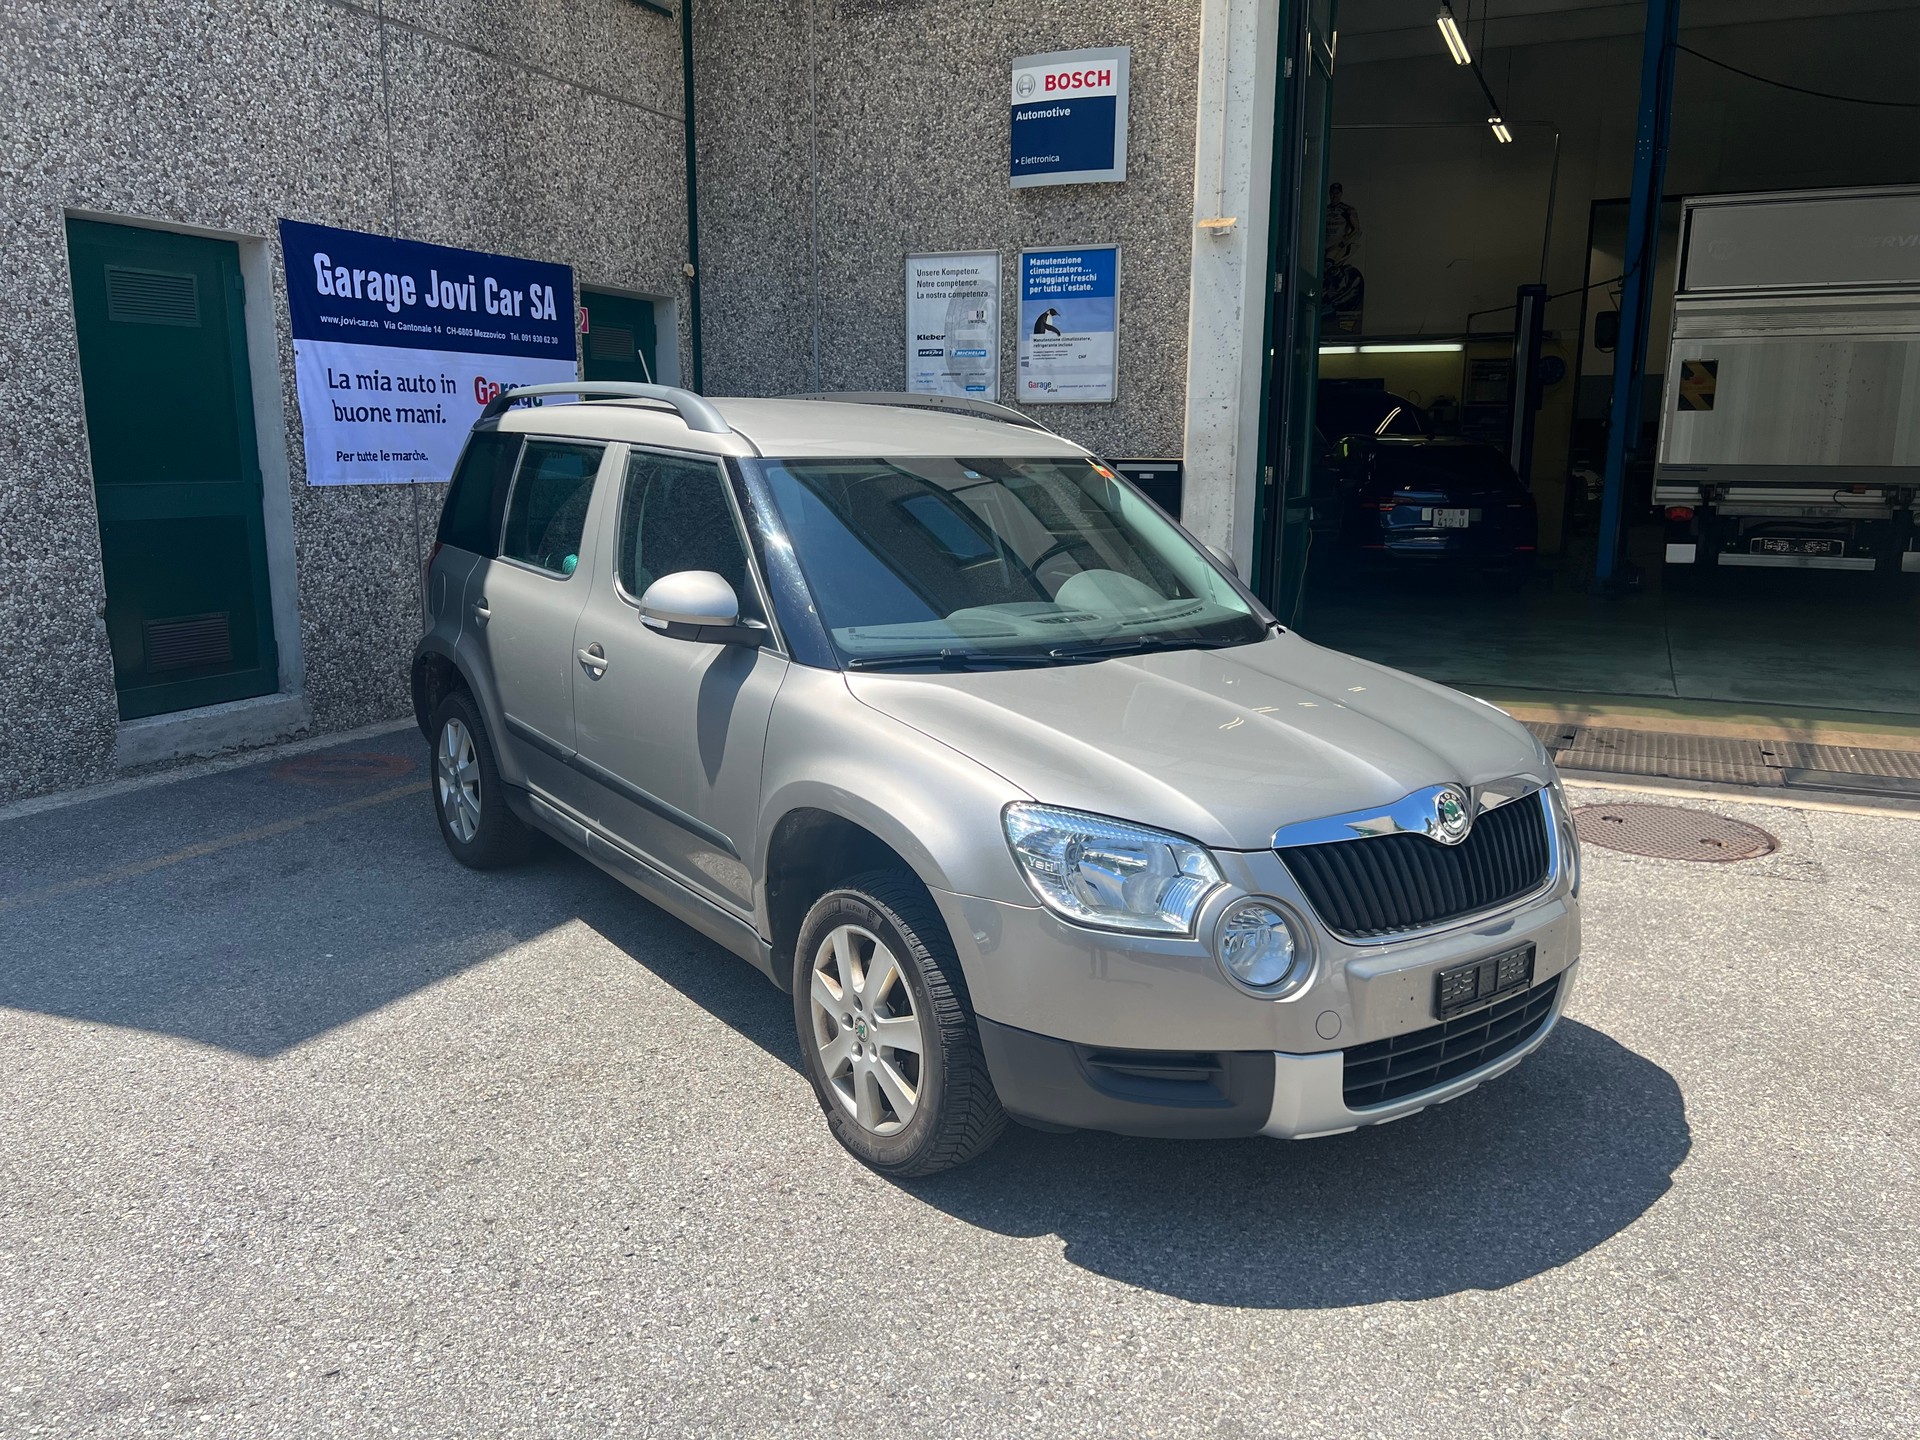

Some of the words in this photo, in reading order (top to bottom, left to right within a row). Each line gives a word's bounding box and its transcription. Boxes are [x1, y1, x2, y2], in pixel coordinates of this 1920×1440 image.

[1045, 70, 1110, 91] BOSCH
[1016, 106, 1071, 121] Automotive
[1020, 154, 1060, 165] Elettronica
[1030, 256, 1082, 266] Manutenzione
[916, 269, 940, 277] Unsere
[941, 268, 980, 277] Kompetenz.
[1029, 266, 1091, 275] climatizzatore...
[916, 280, 935, 288] Notre
[936, 279, 980, 289] compétence.
[1035, 275, 1070, 284] viaggiate
[1070, 273, 1097, 282] freschi
[313, 252, 417, 313] Garage
[425, 270, 477, 312] Jovi
[484, 277, 523, 316] Car
[529, 283, 557, 321] SA
[1029, 286, 1042, 295] per
[1062, 283, 1094, 292] l'estate.
[916, 291, 925, 299] La
[925, 291, 947, 299] nostra
[947, 291, 990, 299] competenza.
[320, 315, 379, 328] www.jovi-car.ch
[384, 320, 396, 329] Via
[397, 321, 432, 333] Cantonale
[433, 325, 442, 334] 14
[446, 326, 473, 337] CH-6805
[474, 329, 506, 340] Mezzovico
[510, 332, 520, 341] Tel.
[521, 333, 531, 342] 091
[532, 334, 543, 343] 930
[543, 335, 551, 344] 62
[551, 336, 559, 345] 30
[327, 367, 351, 390] La
[355, 369, 392, 391] mia
[397, 374, 436, 393] auto
[440, 373, 457, 394] in
[1028, 380, 1052, 390] Garage
[331, 399, 392, 423] buone
[396, 403, 447, 424] mani.
[336, 450, 355, 462] Per
[357, 450, 378, 462] tutte
[380, 449, 390, 462] le
[392, 449, 429, 462] marche.
[1028, 855, 1054, 873] Yeti
